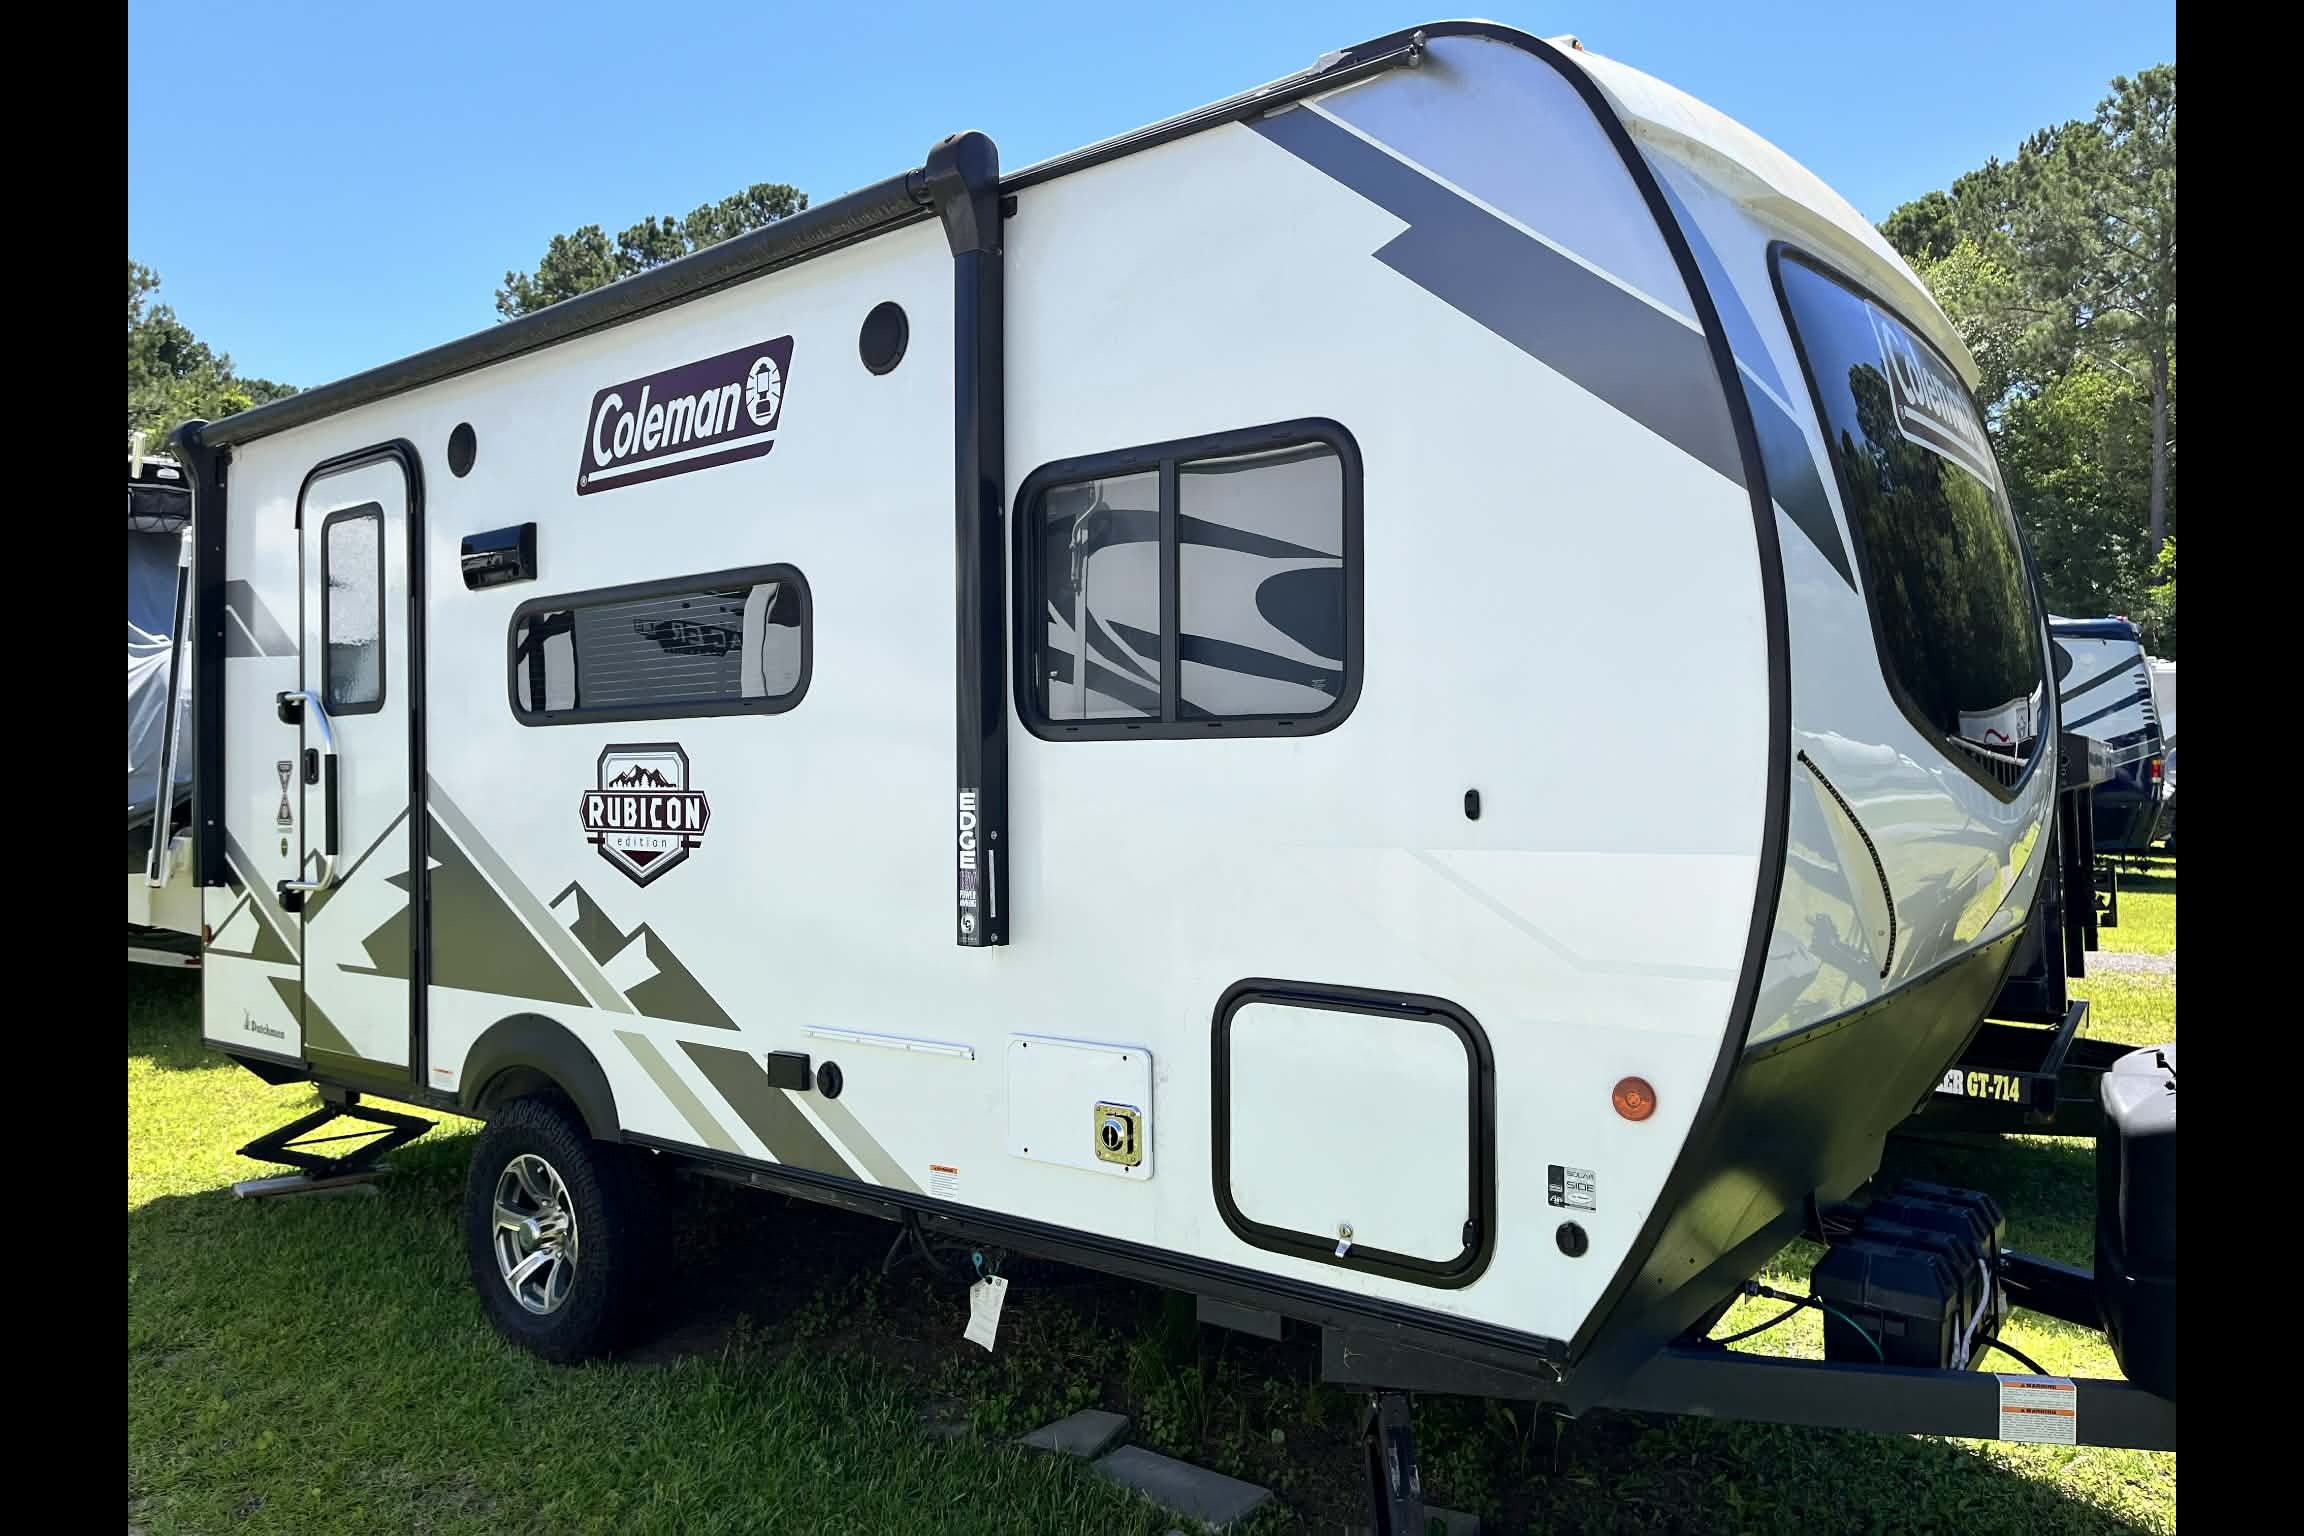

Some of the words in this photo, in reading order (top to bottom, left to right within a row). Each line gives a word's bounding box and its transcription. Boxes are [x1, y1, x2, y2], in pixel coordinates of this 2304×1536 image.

[593, 382, 741, 466] Coleman
[588, 795, 700, 829] RUBICON
[617, 836, 667, 848] edition
[959, 792, 977, 870] EDGE
[1967, 1071, 2020, 1103] GT-714
[1566, 1181, 1595, 1193] SIDE
